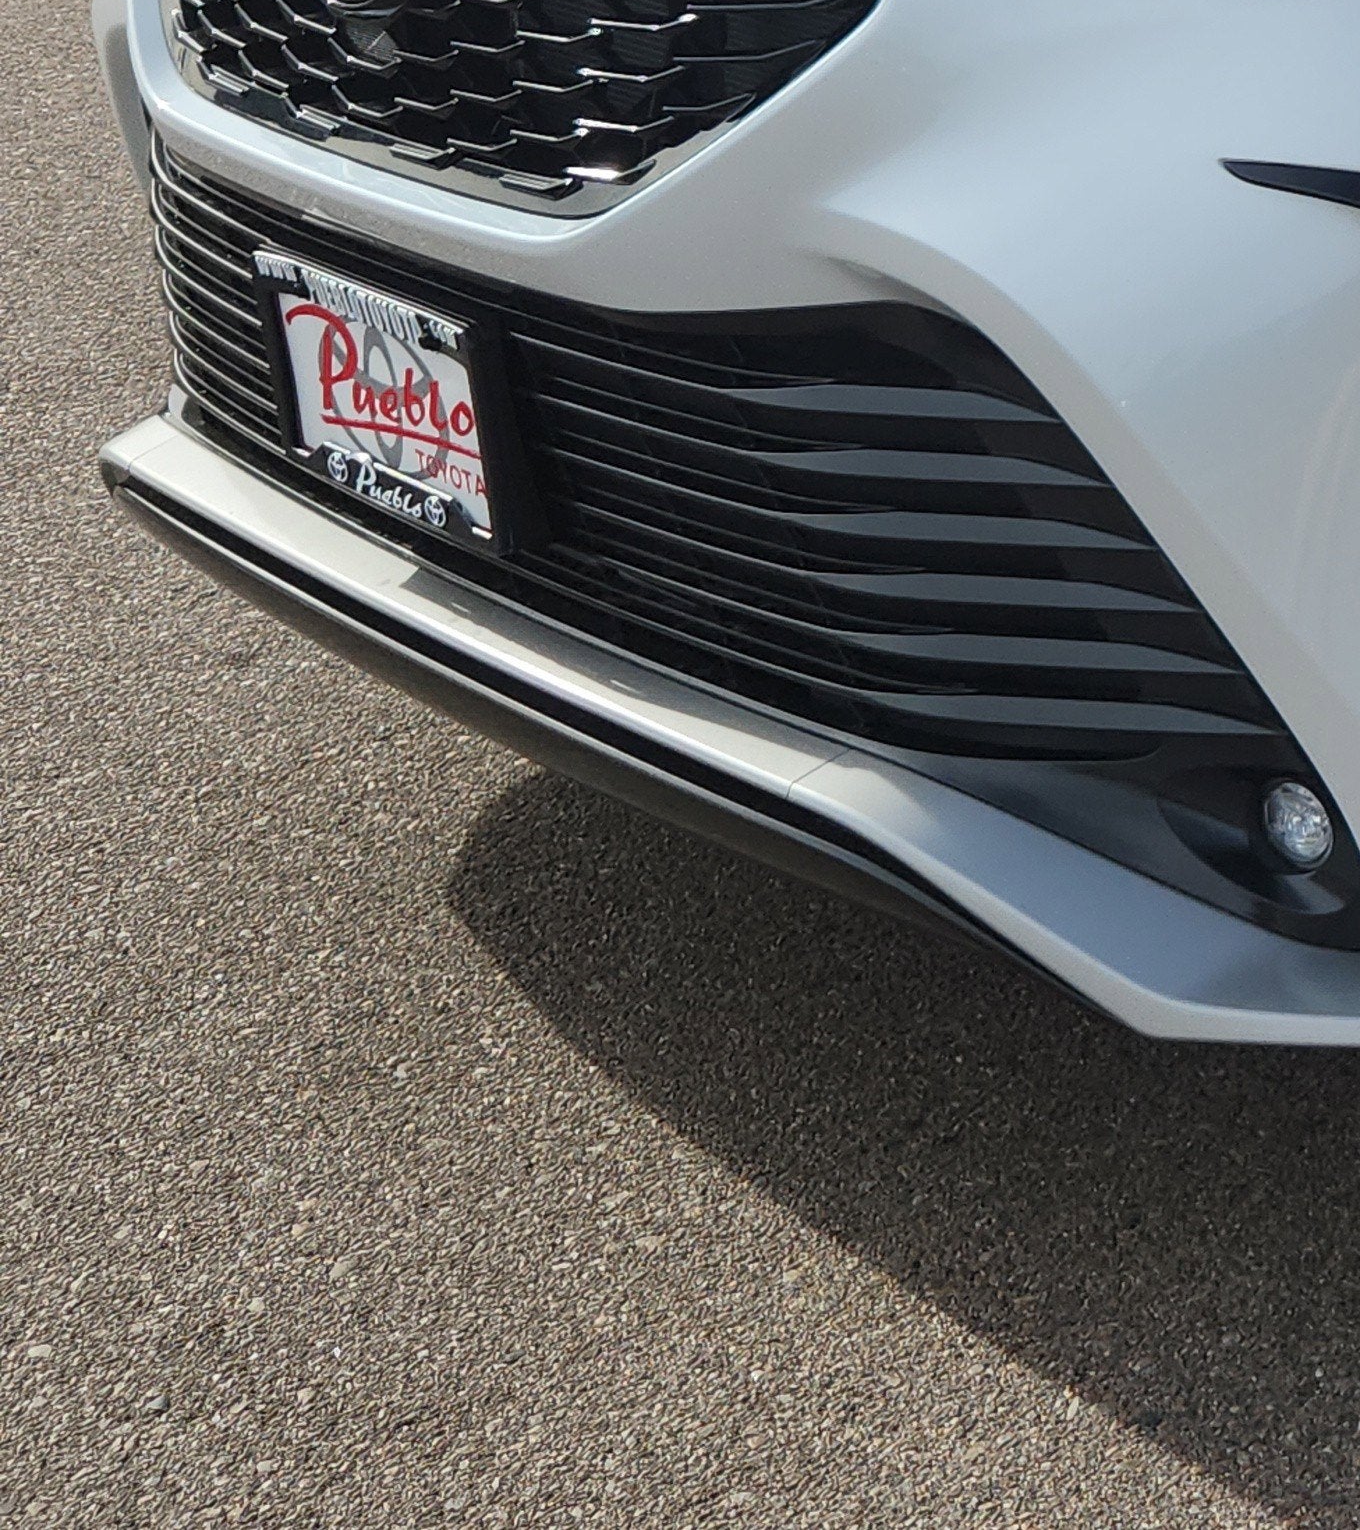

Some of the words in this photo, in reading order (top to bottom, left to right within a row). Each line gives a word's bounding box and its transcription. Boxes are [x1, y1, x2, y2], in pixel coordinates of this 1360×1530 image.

[285, 303, 475, 437] Pueblo
[345, 451, 422, 518] Pueblo
[415, 448, 488, 499] TOYOTA
